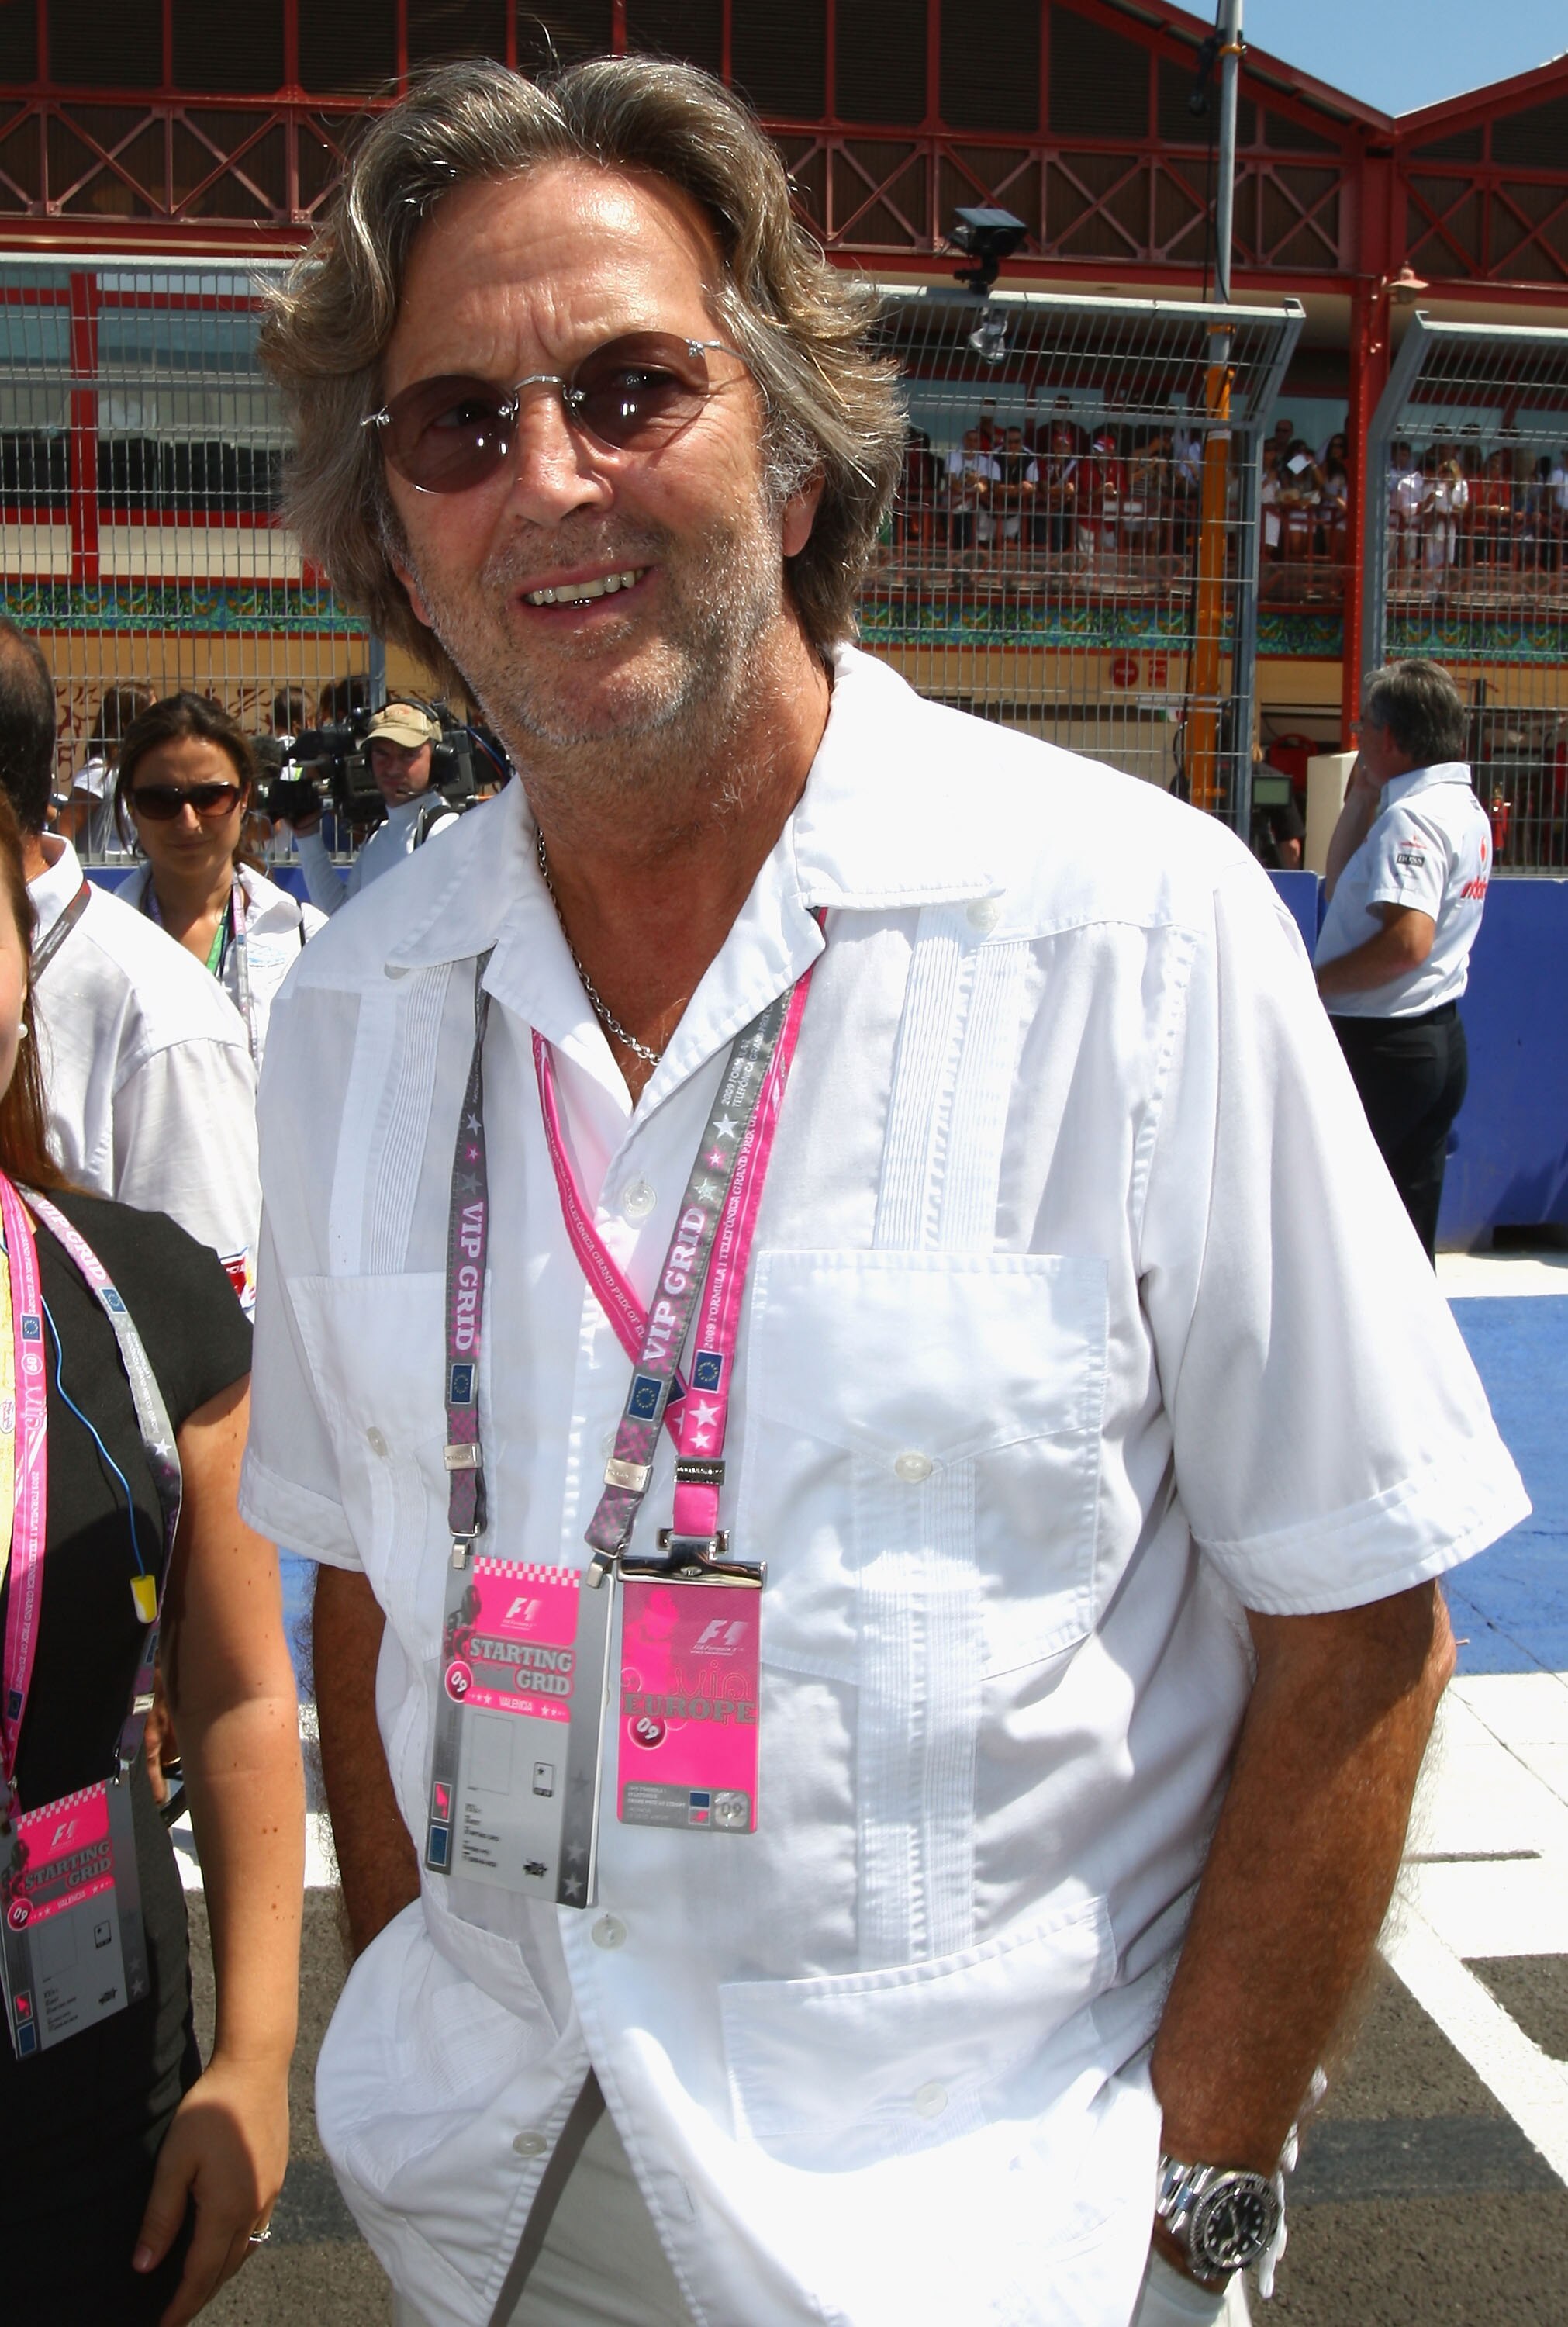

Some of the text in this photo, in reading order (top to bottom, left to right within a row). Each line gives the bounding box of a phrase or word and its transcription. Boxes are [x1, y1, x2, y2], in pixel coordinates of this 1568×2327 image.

[721, 1083, 734, 1105] 2009
[741, 1129, 755, 1154] PRIX
[733, 1153, 748, 1197] GRAND
[38, 1201, 107, 1281] VIP GRID
[720, 1195, 741, 1260] TELEFÓNICA
[455, 1202, 484, 1350] VIP GRID
[643, 1207, 705, 1361] VIP GRID
[592, 1251, 613, 1288] GRAND
[610, 1285, 630, 1311] PRIX
[626, 1309, 638, 1323] OF
[634, 1323, 645, 1340] EU
[708, 1268, 727, 1323] FORMULA
[703, 1324, 717, 1349] 2009
[26, 1357, 38, 1372] 09
[24, 1591, 34, 1621] GRAND
[505, 1597, 541, 1621] F1
[21, 1622, 31, 1644] PRIX
[696, 1619, 749, 1646] F1
[469, 1638, 572, 1672] STARTING
[451, 1671, 468, 1693] 09
[516, 1668, 570, 1696] GRID
[499, 1696, 534, 1712] VALENCIA
[623, 1693, 758, 1725] EUROPE
[636, 1717, 661, 1741] 09
[720, 1801, 743, 1818] 09
[51, 1819, 77, 1846] F1
[25, 1841, 110, 1890] STARTING
[68, 1858, 111, 1886] GRID
[57, 1890, 86, 1909] VALENCIA
[13, 1907, 29, 1923] 09
